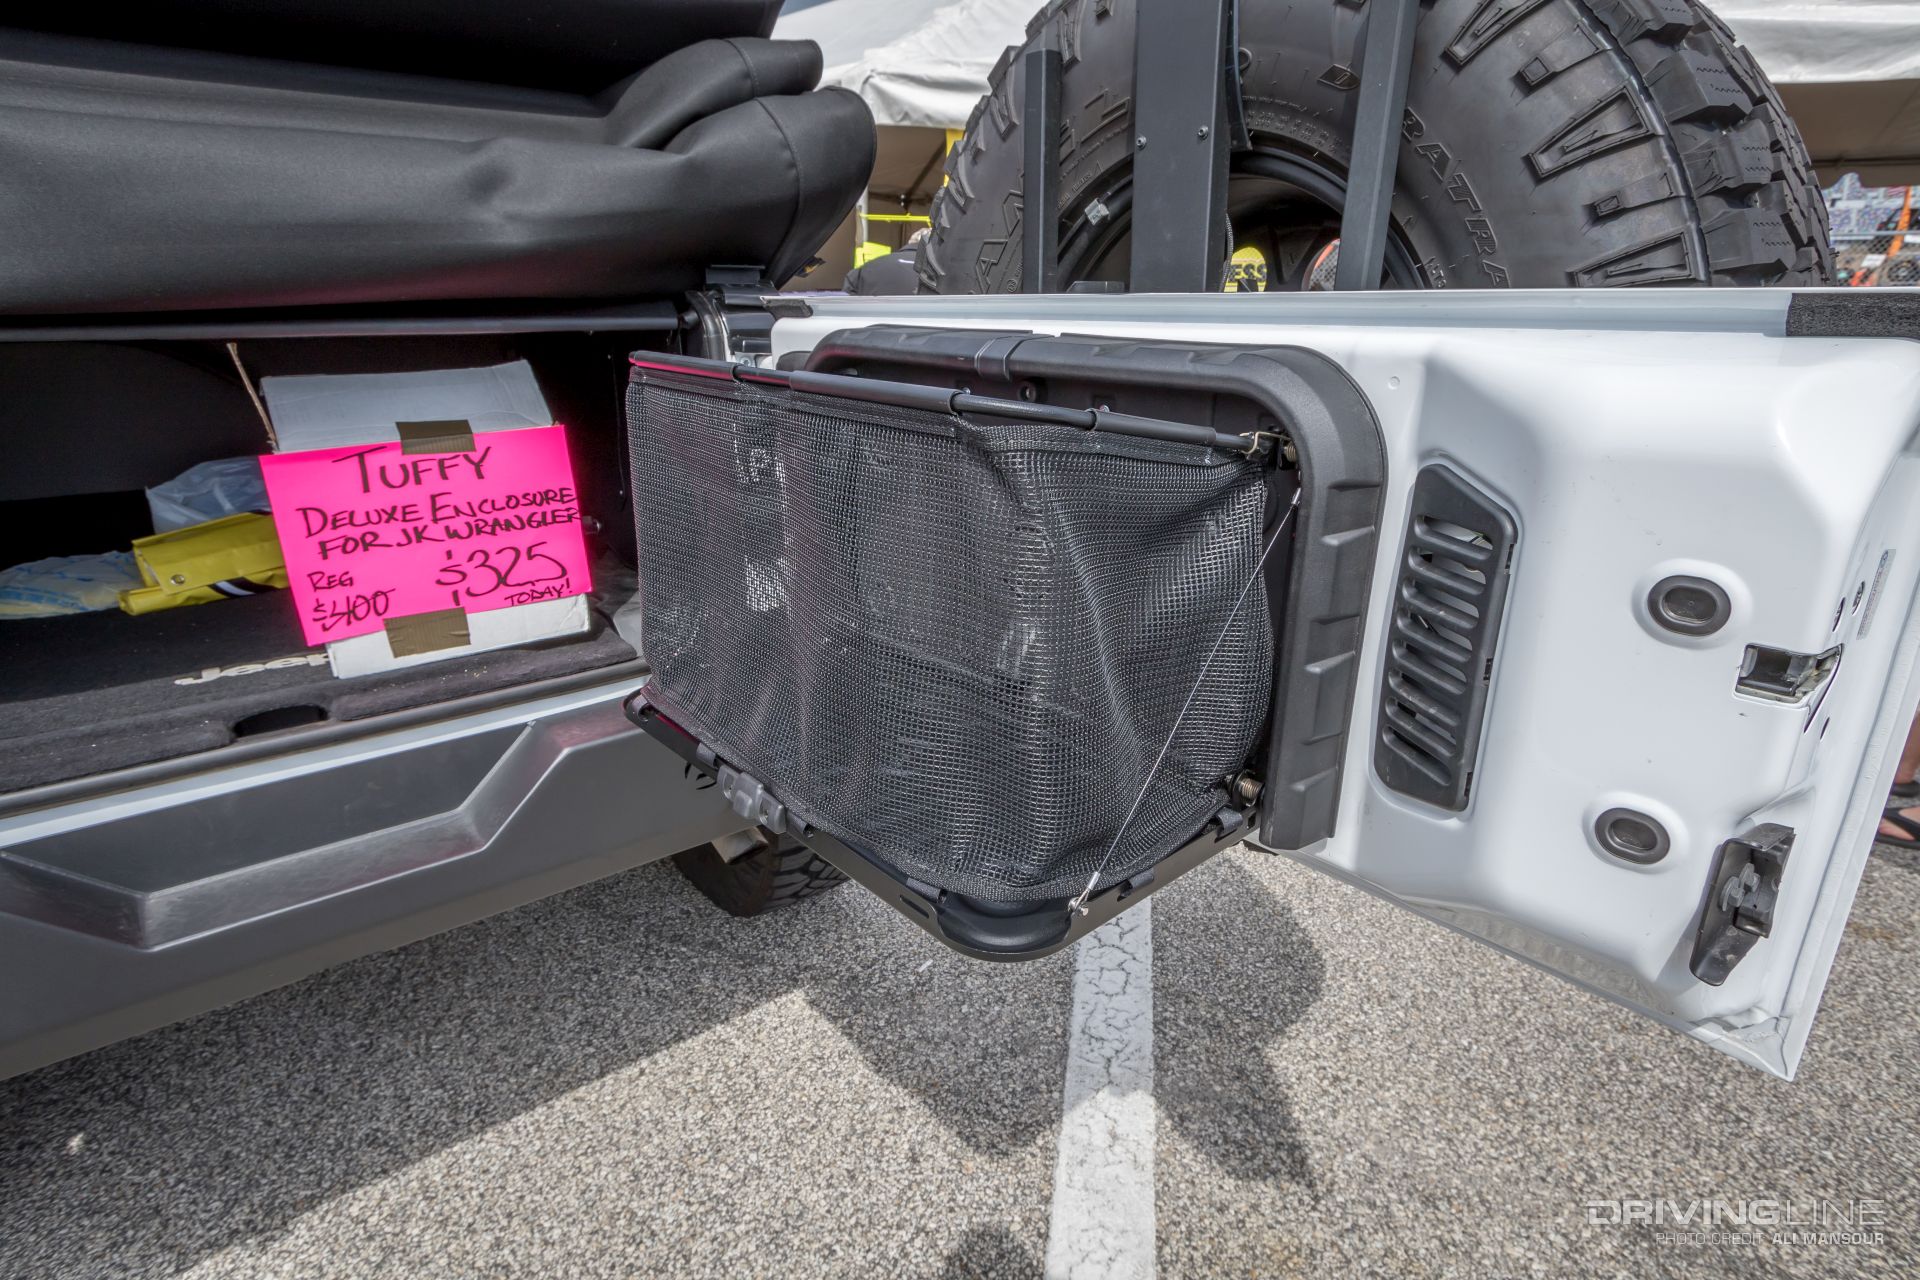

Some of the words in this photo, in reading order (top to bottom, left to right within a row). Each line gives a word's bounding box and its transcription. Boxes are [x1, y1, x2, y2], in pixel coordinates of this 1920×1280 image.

[332, 446, 492, 493] TUFFY
[296, 504, 424, 539] DELUXE
[430, 488, 577, 524] ENCLOSURE
[318, 531, 394, 560] FOR
[397, 525, 445, 547] JK
[445, 507, 581, 539] WRANGLER
[307, 571, 353, 592] REG
[435, 541, 567, 607] $325
[504, 578, 573, 607] TODAY!
